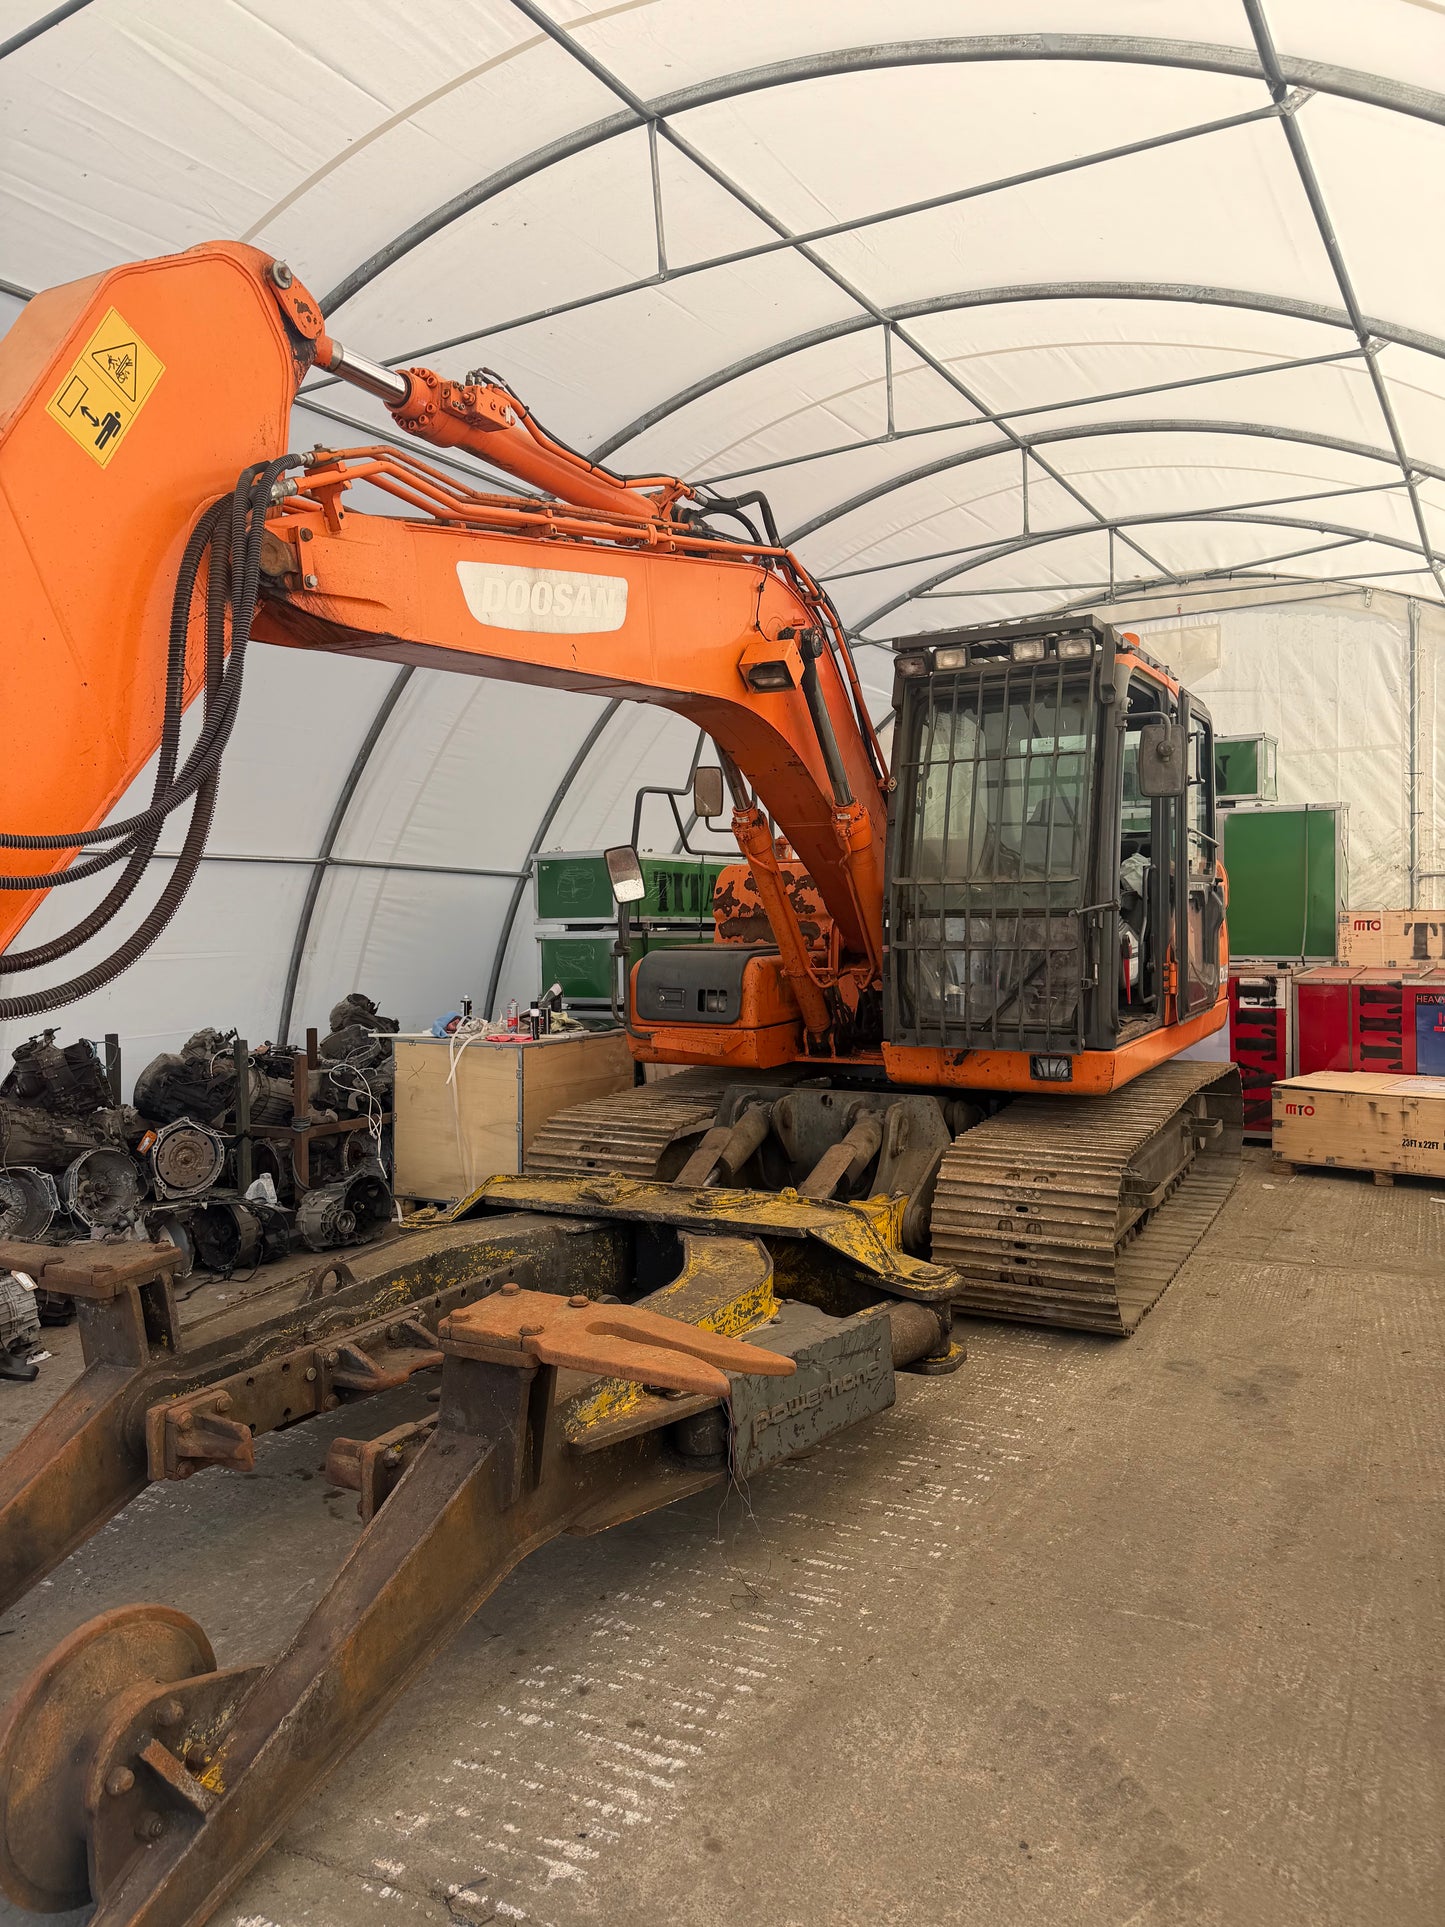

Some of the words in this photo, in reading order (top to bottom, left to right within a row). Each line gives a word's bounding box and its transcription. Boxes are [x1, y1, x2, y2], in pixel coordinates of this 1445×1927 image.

[481, 577, 616, 618] DOOSAN
[1353, 920, 1382, 931] MTO
[1360, 981, 1403, 1071] TIT
[1285, 1103, 1315, 1116] MTO
